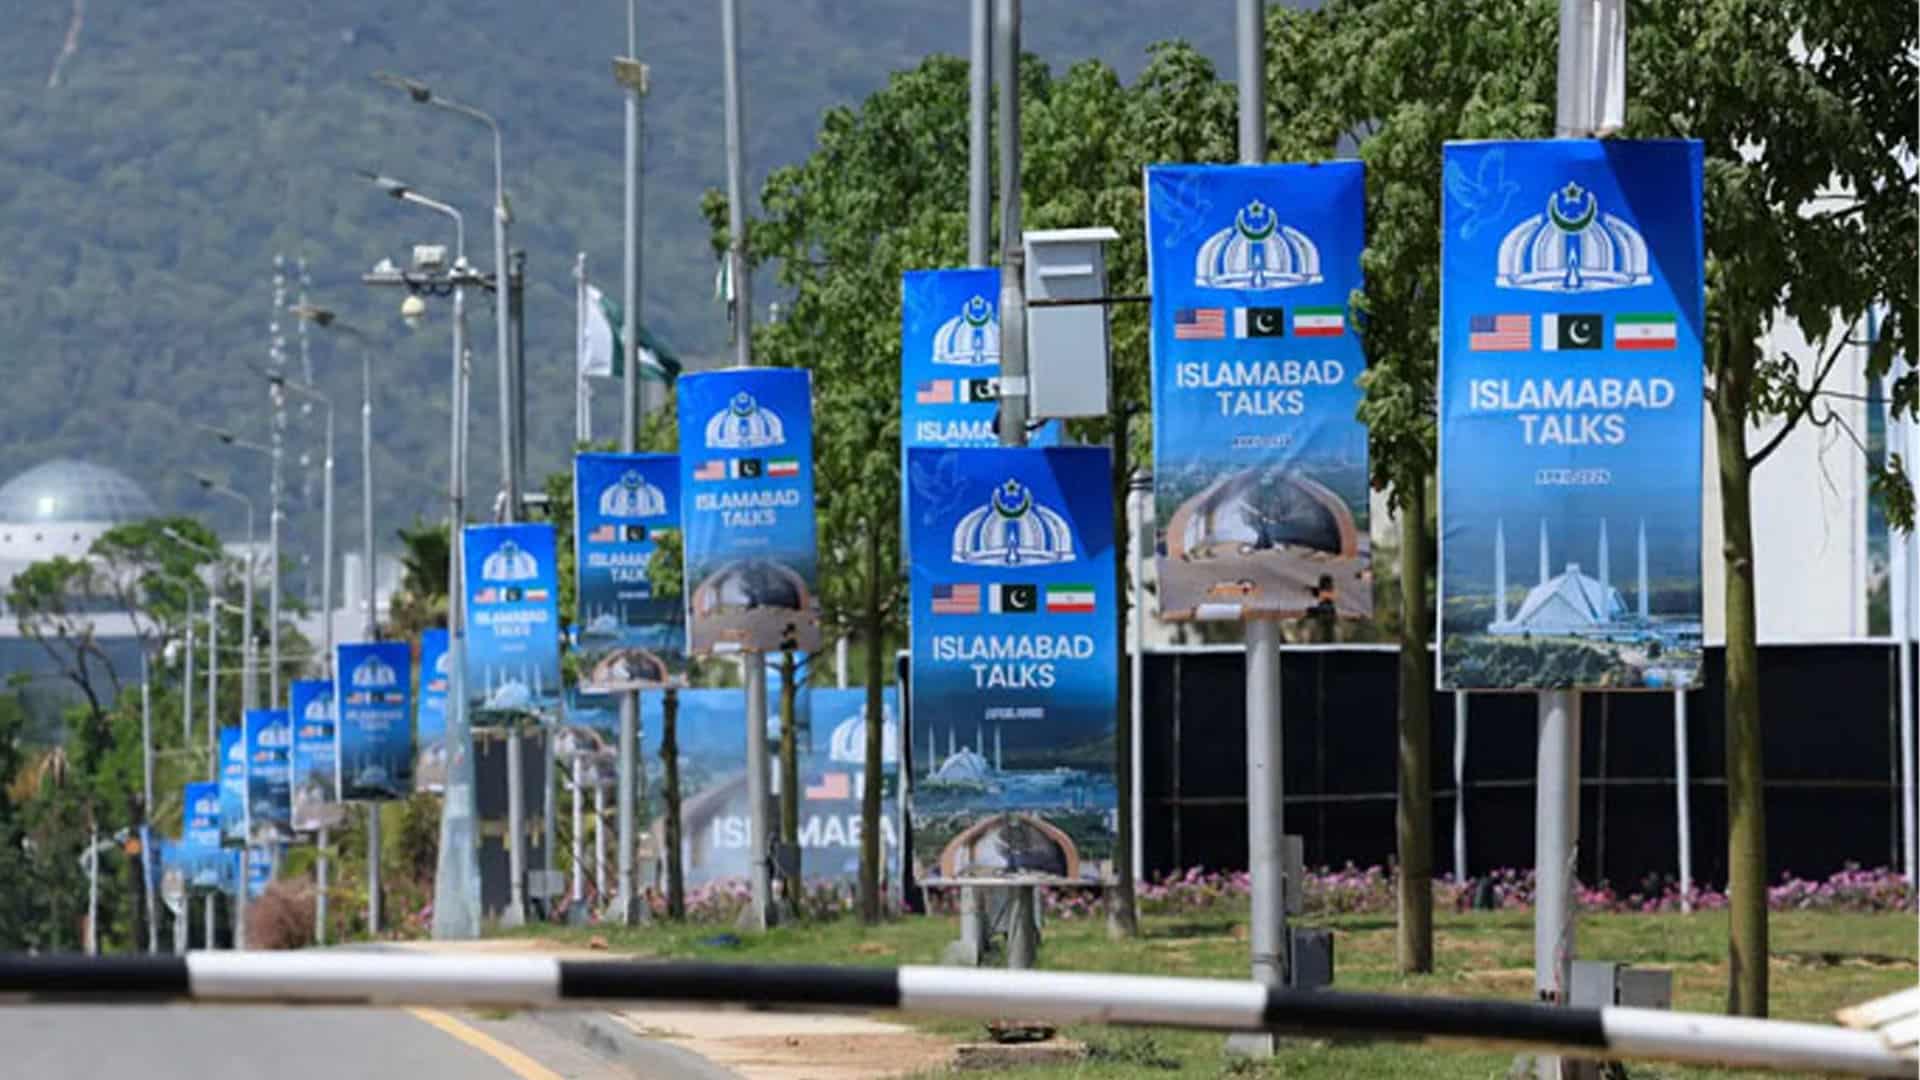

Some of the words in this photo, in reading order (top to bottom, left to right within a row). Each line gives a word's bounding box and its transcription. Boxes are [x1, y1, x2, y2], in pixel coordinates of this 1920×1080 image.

[1176, 360, 1345, 388] ISLAMABAD
[1216, 389, 1305, 416] TALKS
[1470, 378, 1675, 410] ISLAMABAD
[917, 421, 998, 441] ISLAMA
[1518, 413, 1627, 445] TALKS
[932, 635, 1095, 661] ISLAMABAD
[971, 664, 1056, 689] TALKS
